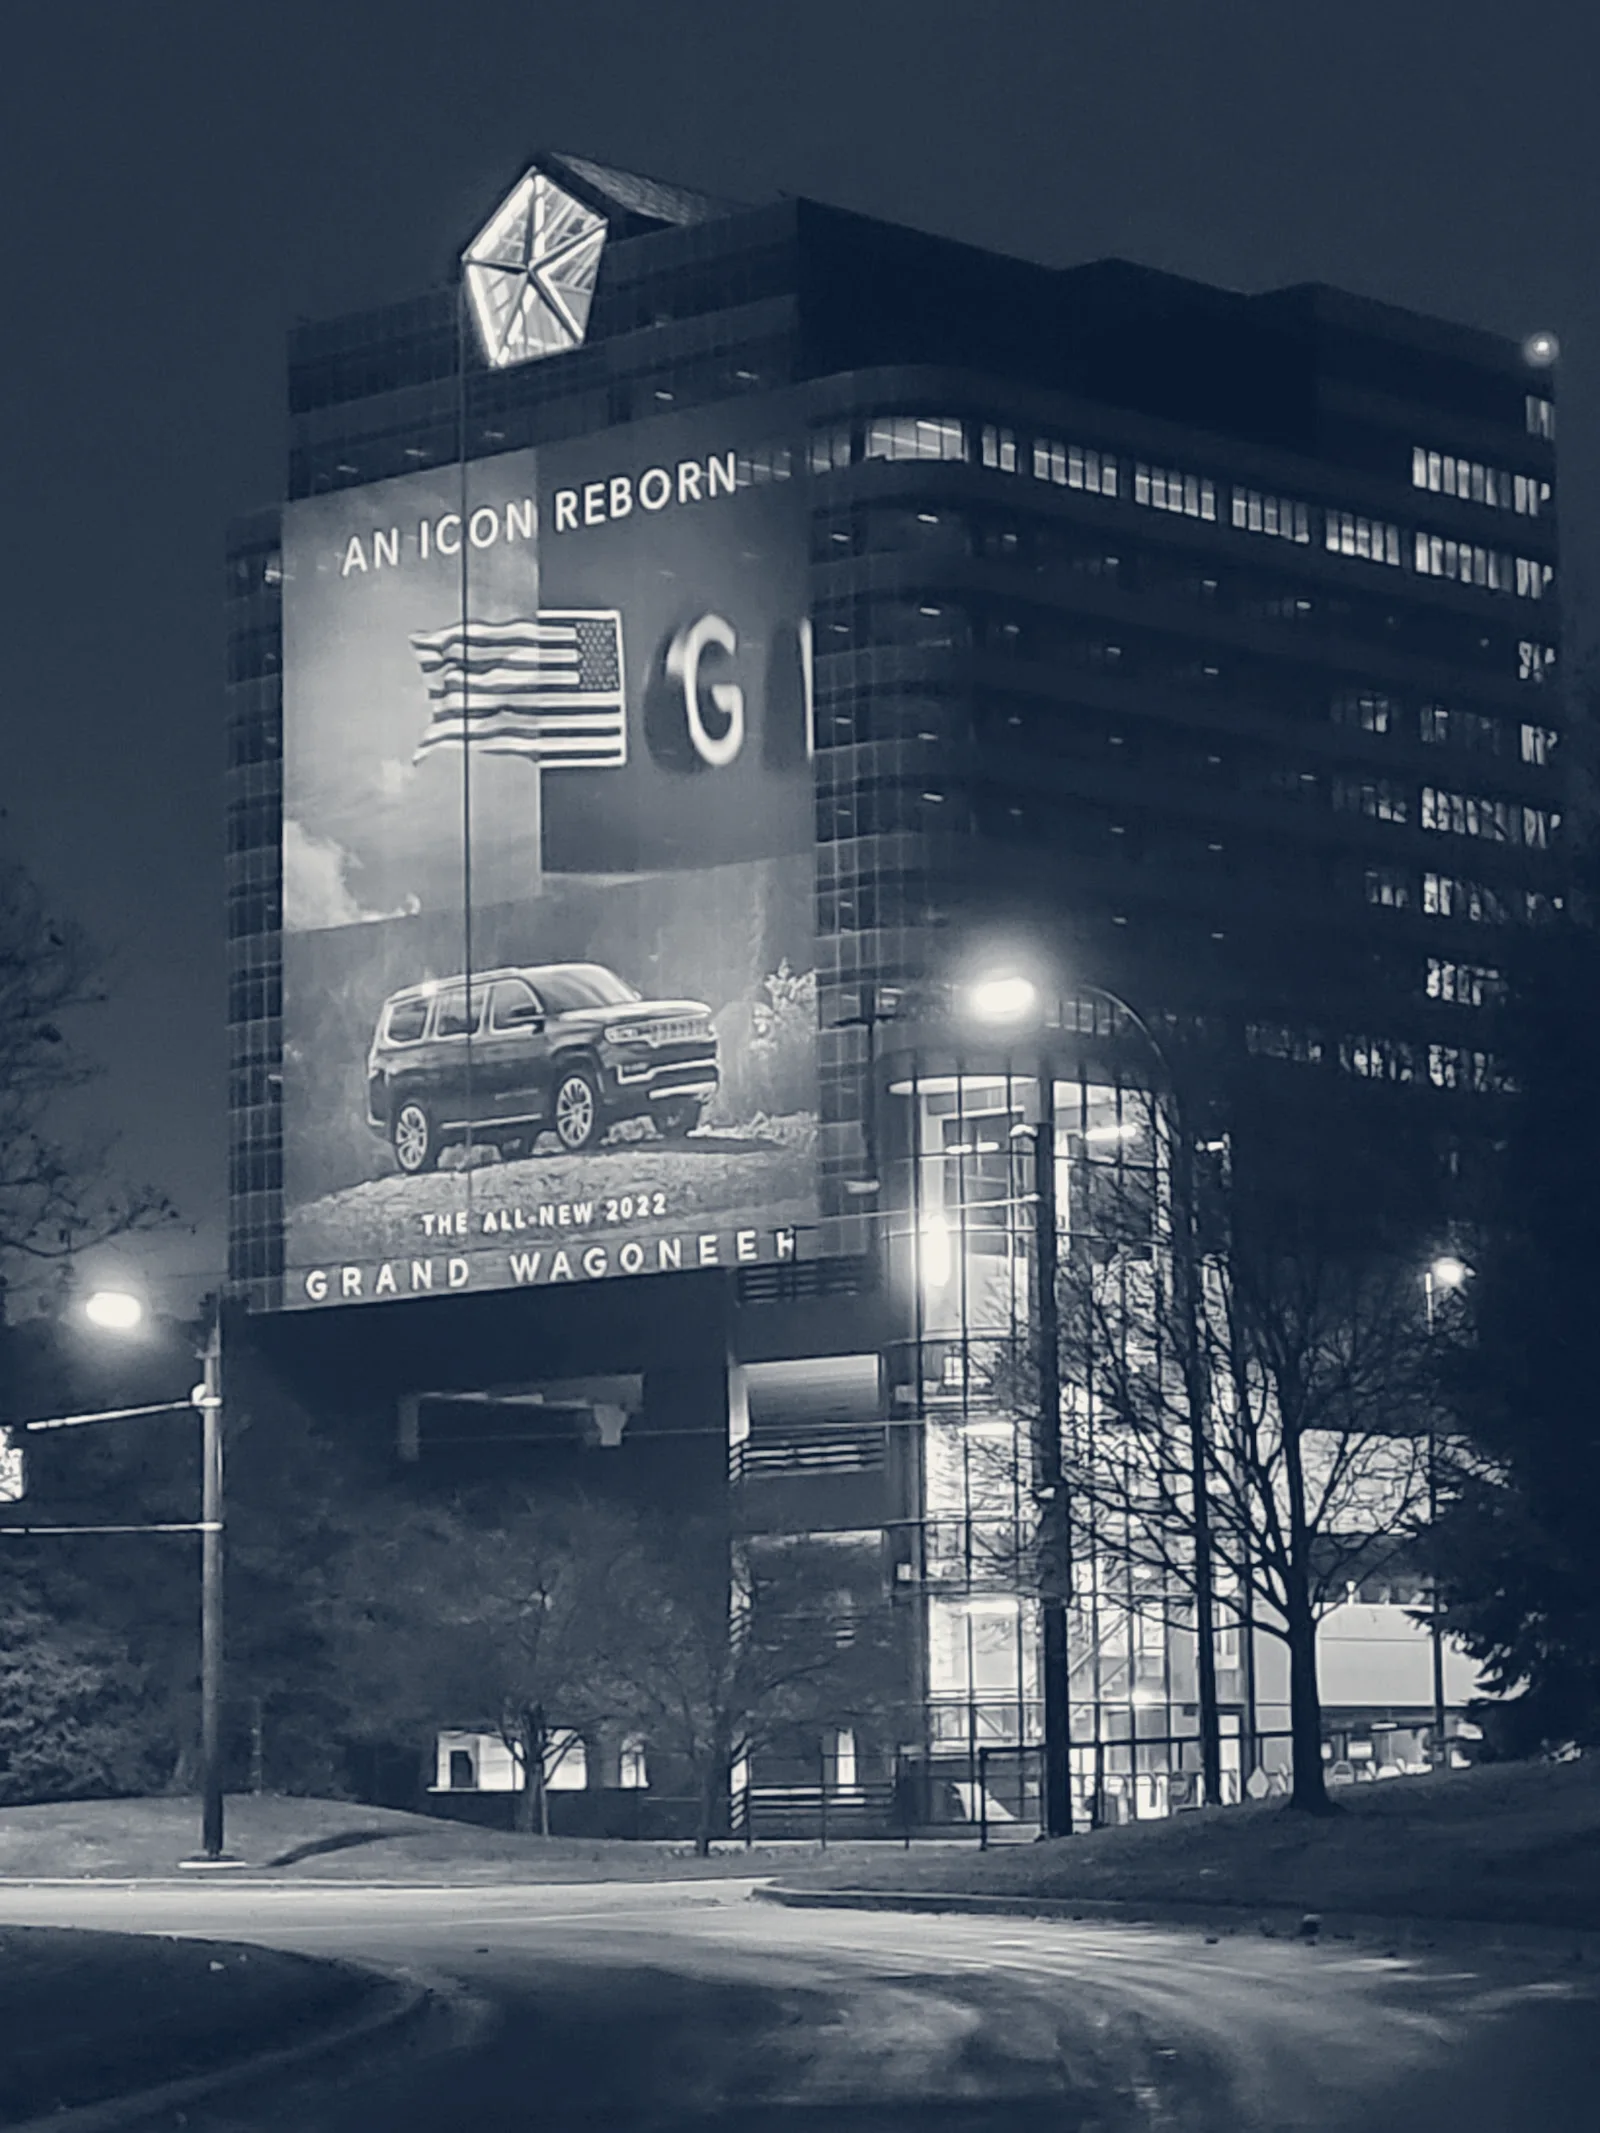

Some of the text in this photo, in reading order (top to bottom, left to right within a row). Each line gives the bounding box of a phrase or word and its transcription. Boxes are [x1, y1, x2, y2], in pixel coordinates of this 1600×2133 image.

[341, 451, 737, 578] AN ICON REBORN
[422, 1192, 667, 1236] THE ALL-NEW 2022
[305, 1257, 470, 1300] GRAND
